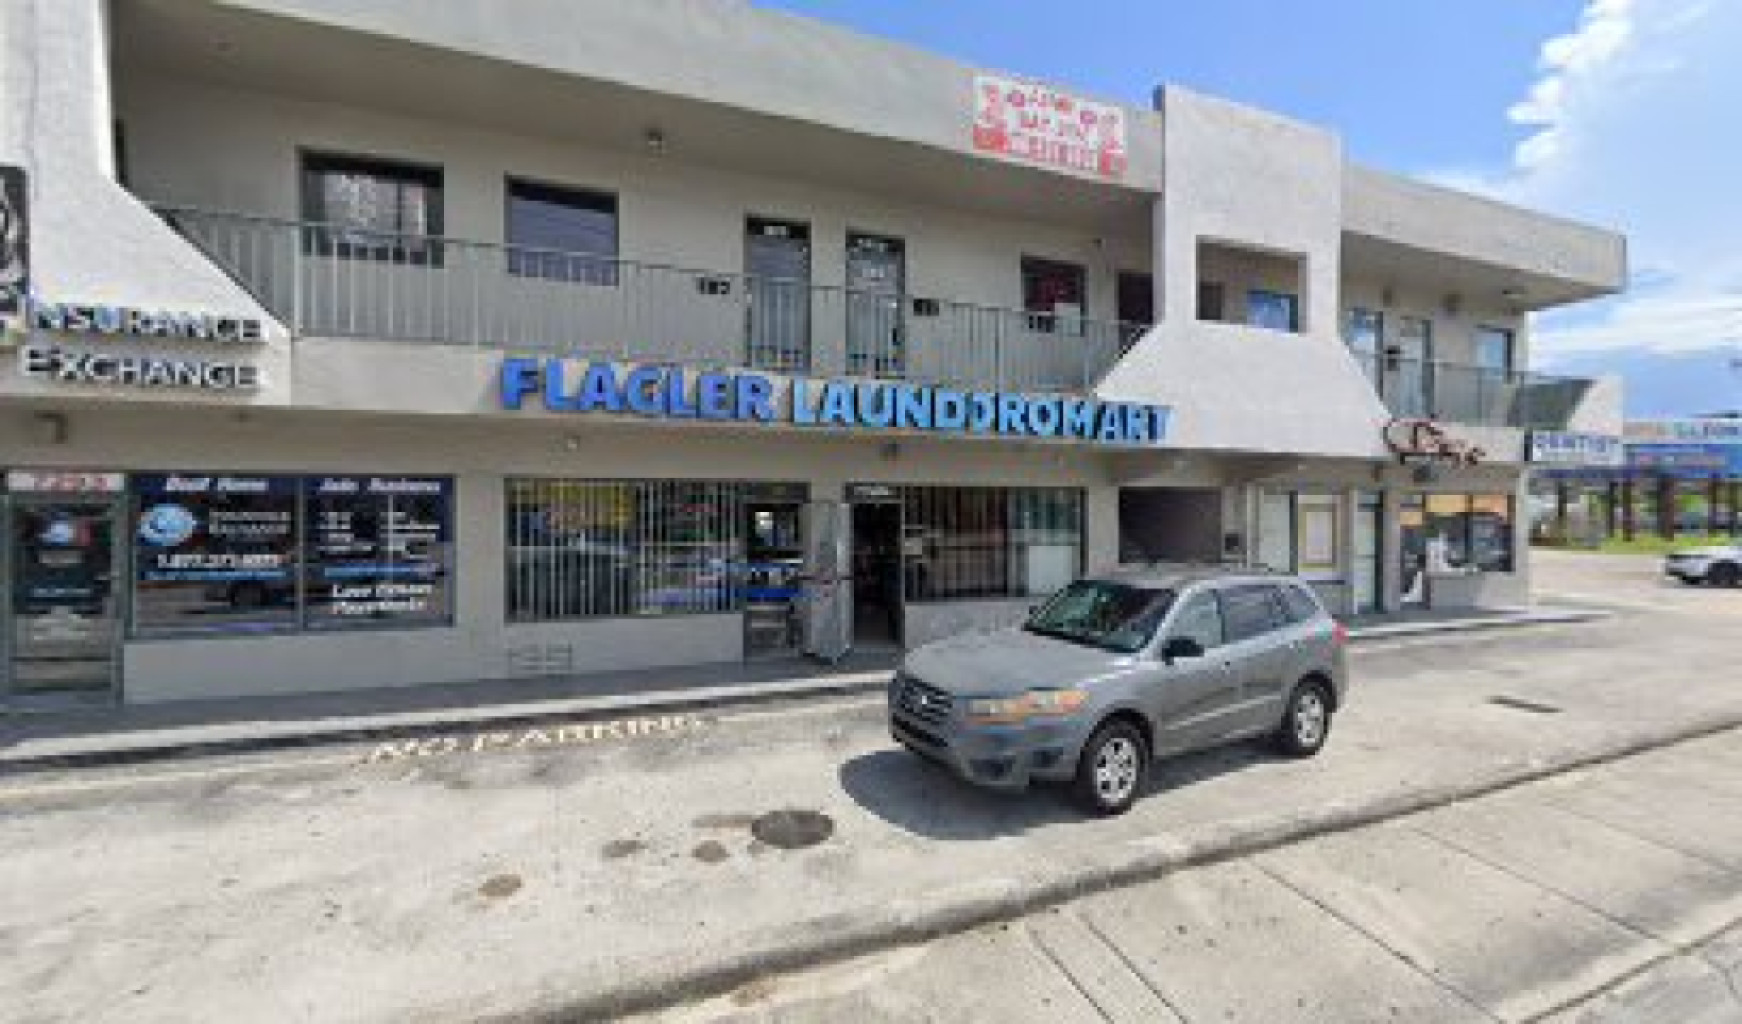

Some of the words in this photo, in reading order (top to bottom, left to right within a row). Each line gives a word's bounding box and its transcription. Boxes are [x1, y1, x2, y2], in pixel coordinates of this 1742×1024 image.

[23, 346, 262, 391] EXCHANGE
[501, 358, 776, 422] FLAGLER
[472, 714, 714, 753] PARKING
